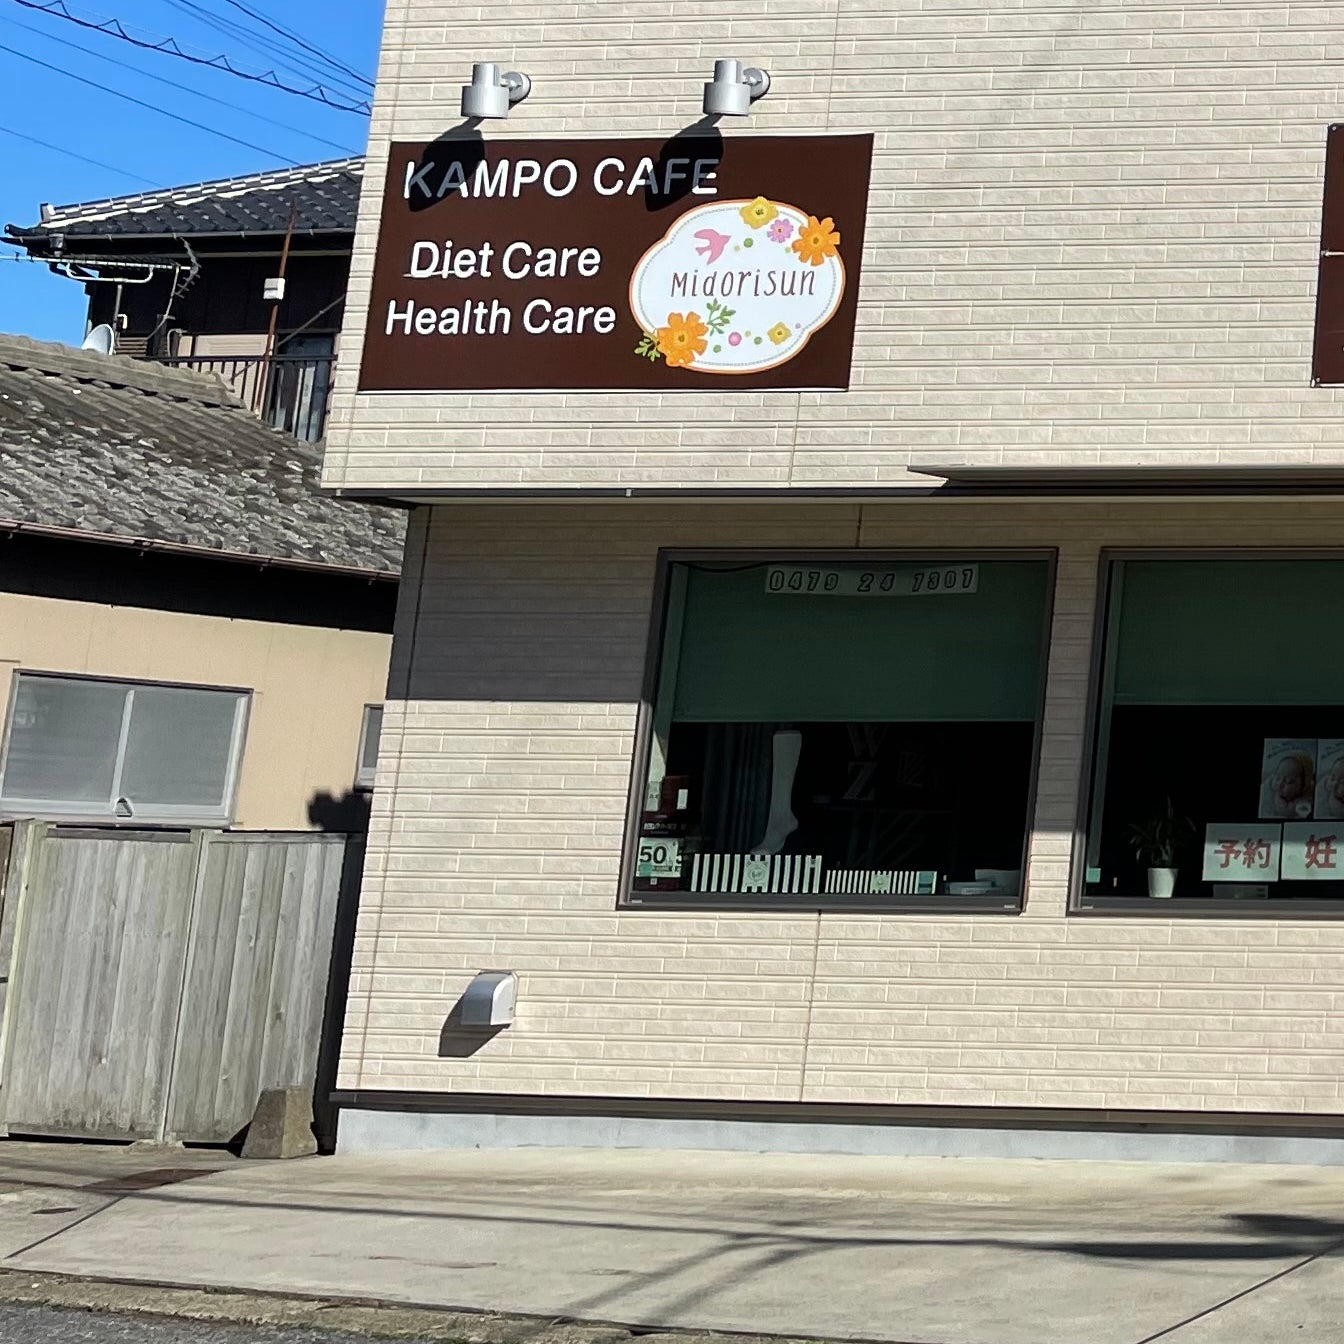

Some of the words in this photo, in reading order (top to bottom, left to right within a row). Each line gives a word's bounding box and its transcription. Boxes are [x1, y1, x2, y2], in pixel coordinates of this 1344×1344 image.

[404, 159, 577, 198] KAMPO
[594, 157, 719, 196] CAFE
[409, 240, 493, 279] Diet
[502, 242, 601, 279] Care
[670, 267, 816, 298] Midorisun
[385, 299, 511, 335] Health
[523, 301, 616, 334] Care
[769, 569, 839, 592] 0479
[857, 572, 894, 592] 24
[912, 568, 974, 592] 7307
[1214, 838, 1271, 869] 予約
